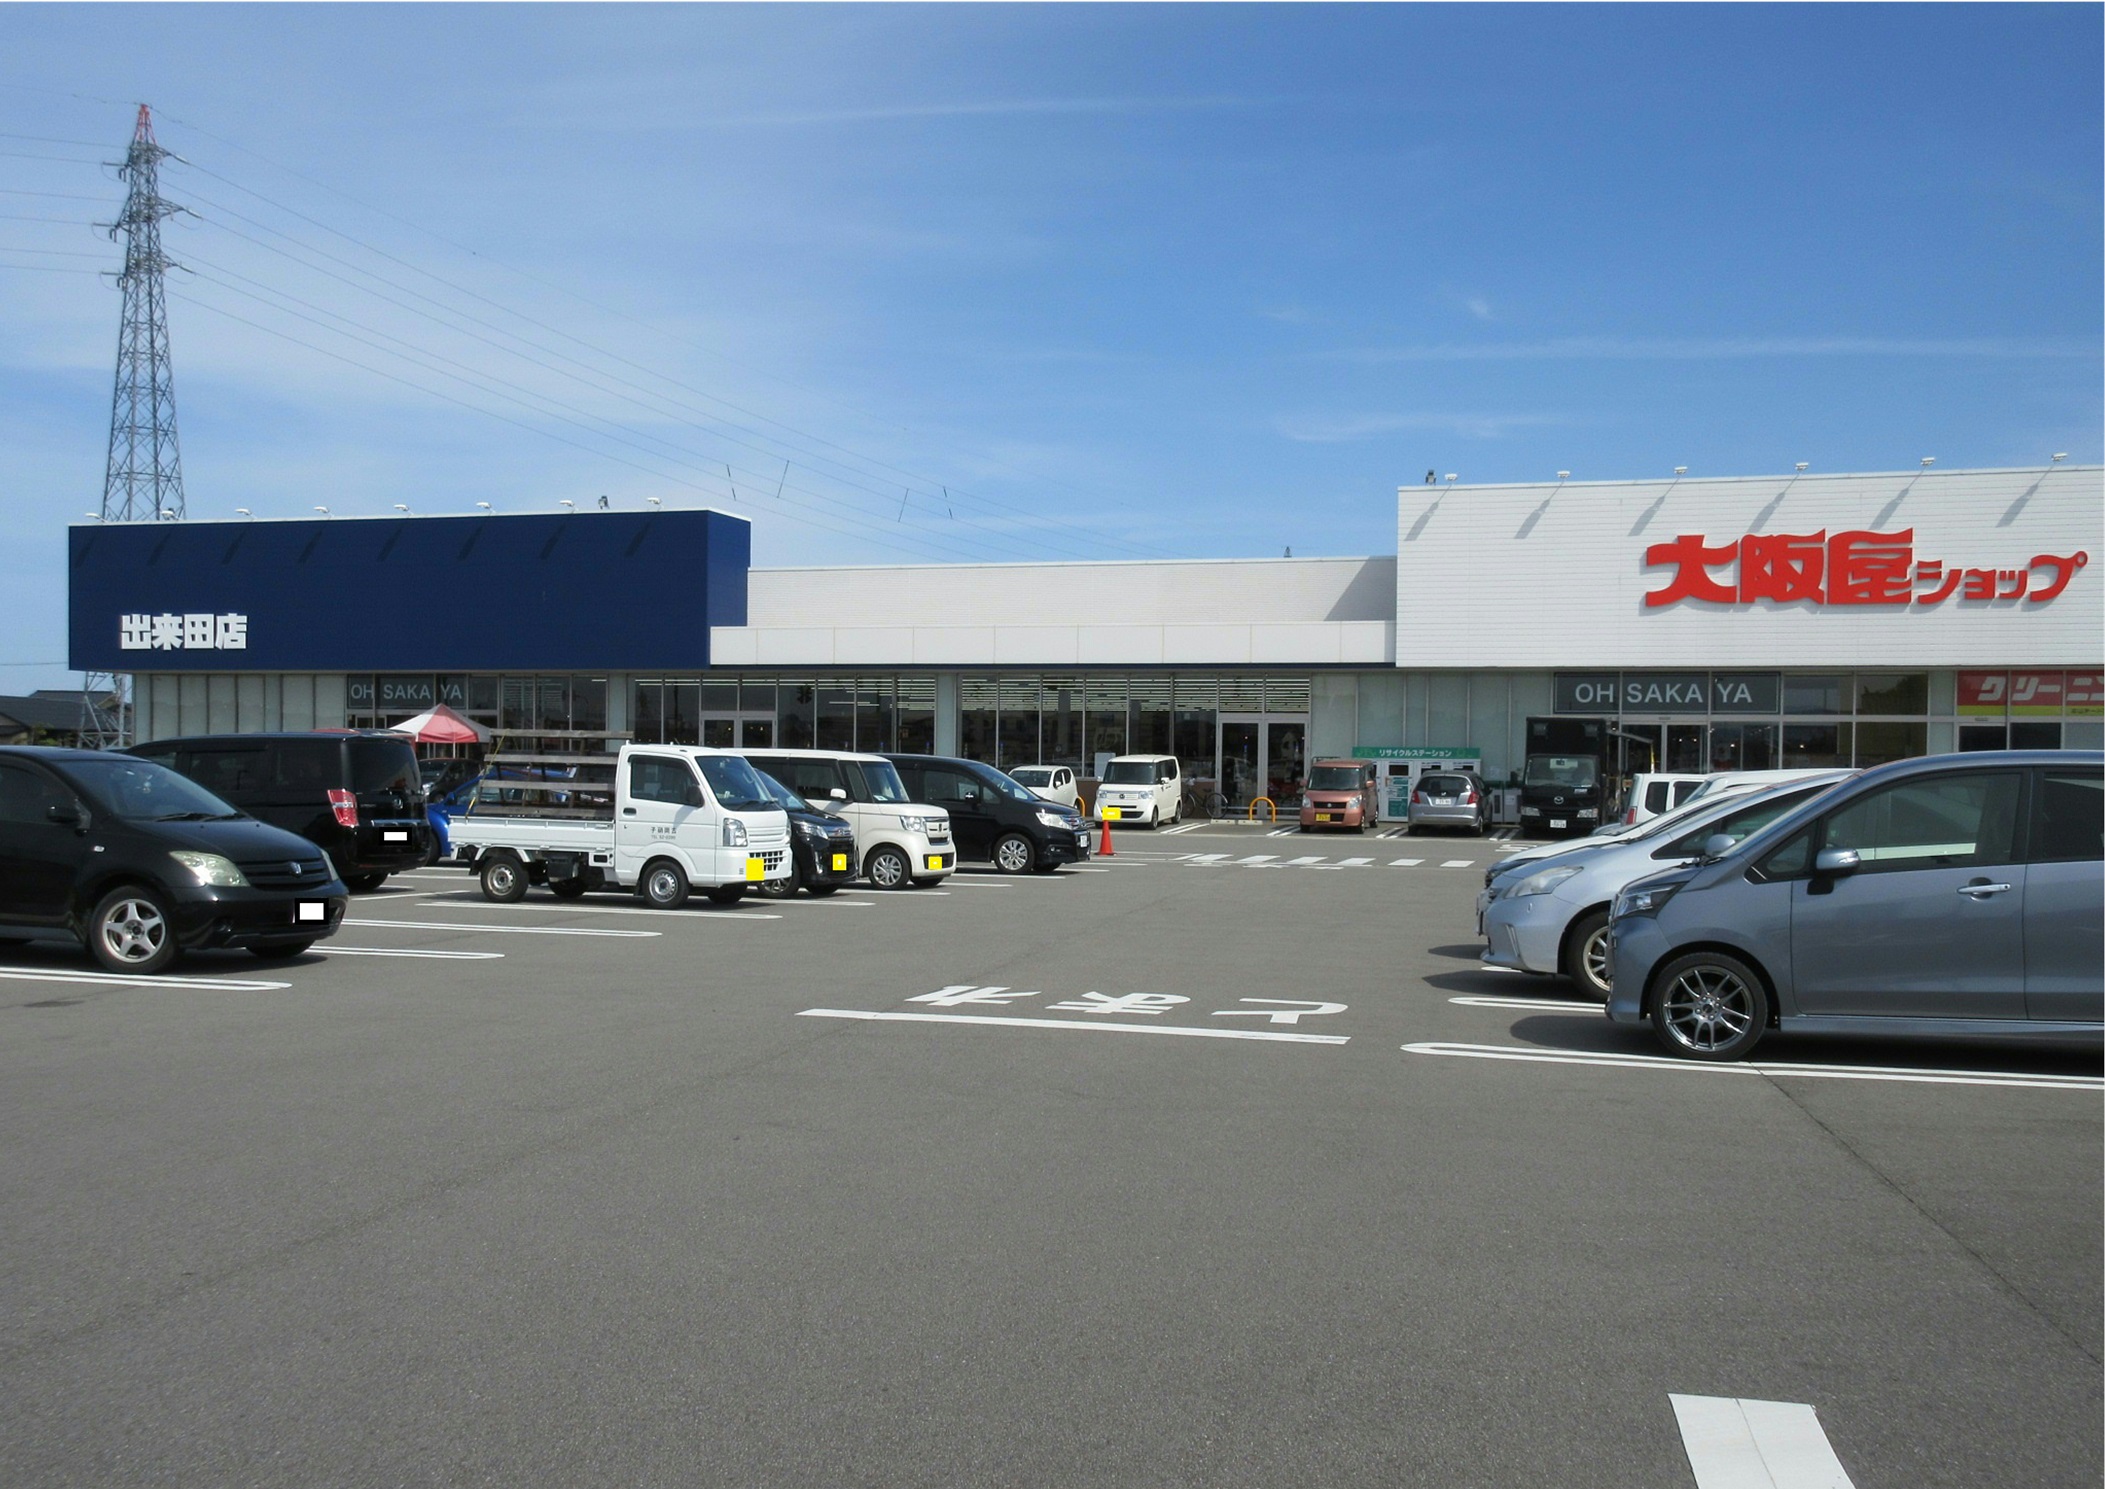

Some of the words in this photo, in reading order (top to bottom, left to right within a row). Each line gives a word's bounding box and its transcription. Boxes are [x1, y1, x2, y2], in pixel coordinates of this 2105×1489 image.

[1646, 529, 2087, 609] 大阪屋ショップ
[120, 612, 249, 651] 出来田店
[350, 683, 374, 700] OH
[383, 683, 431, 700] SAKA
[439, 683, 463, 700] YA
[1575, 683, 1614, 703] OH
[1626, 682, 1703, 703] SAKA
[1716, 682, 1753, 703] YA
[1379, 748, 1452, 758] リサイクルステーション
